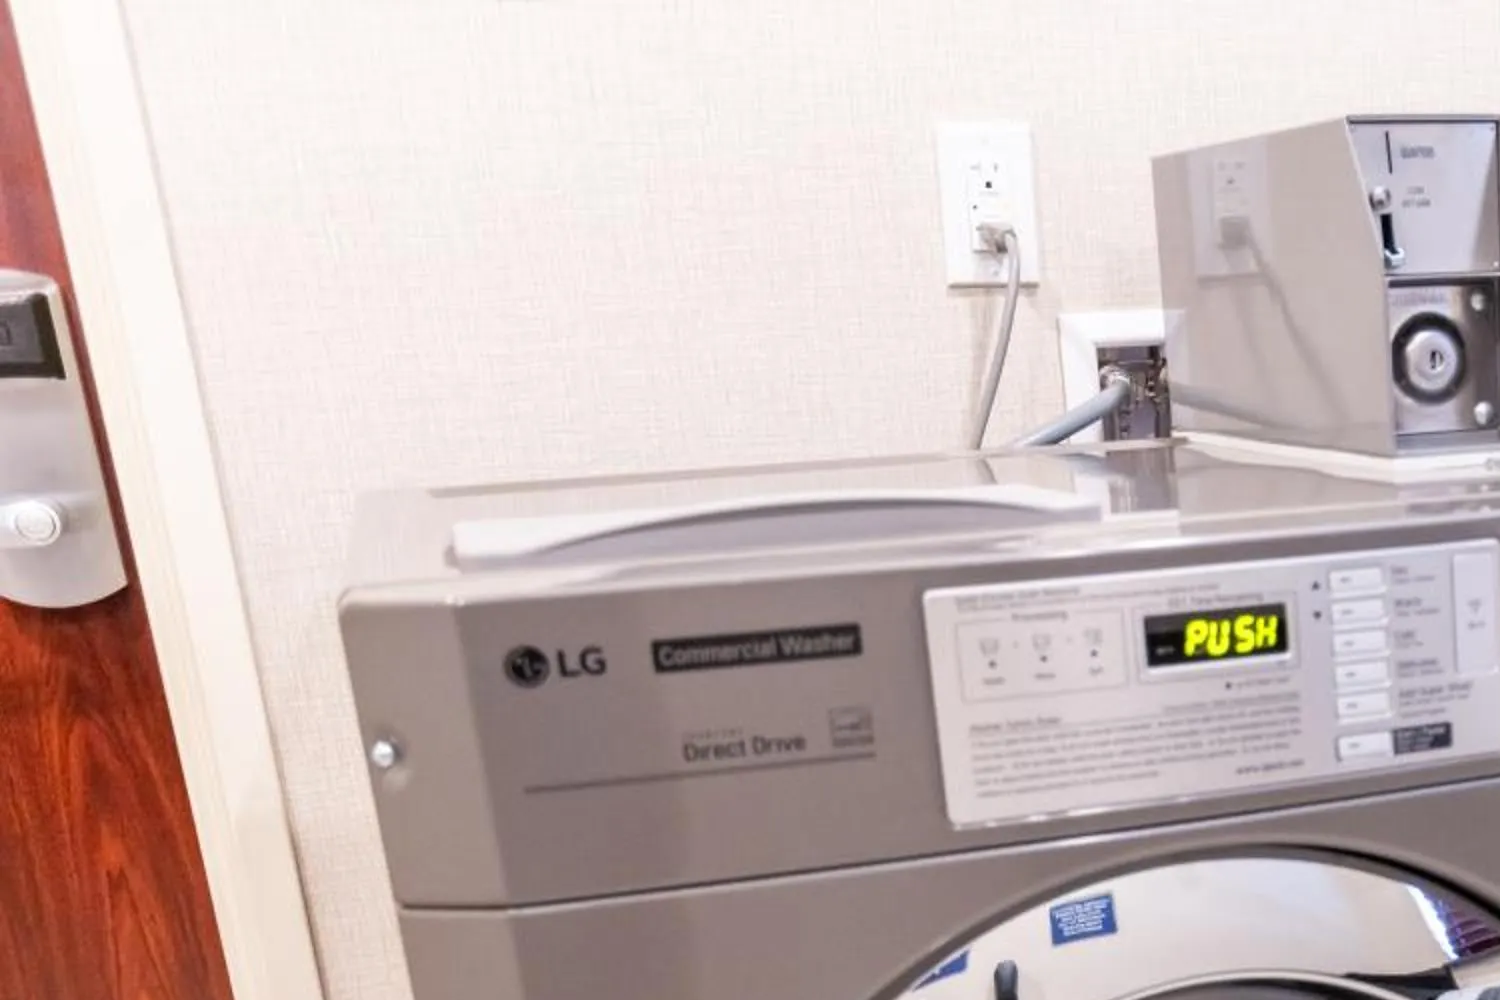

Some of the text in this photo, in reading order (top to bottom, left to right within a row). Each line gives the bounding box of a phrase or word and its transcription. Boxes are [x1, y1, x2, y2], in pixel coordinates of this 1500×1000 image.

[658, 632, 855, 667] Commercial Washer
[1184, 614, 1278, 657] PUSH
[556, 645, 607, 678] LG
[682, 740, 747, 763] Direct
[751, 734, 807, 757] Drive
